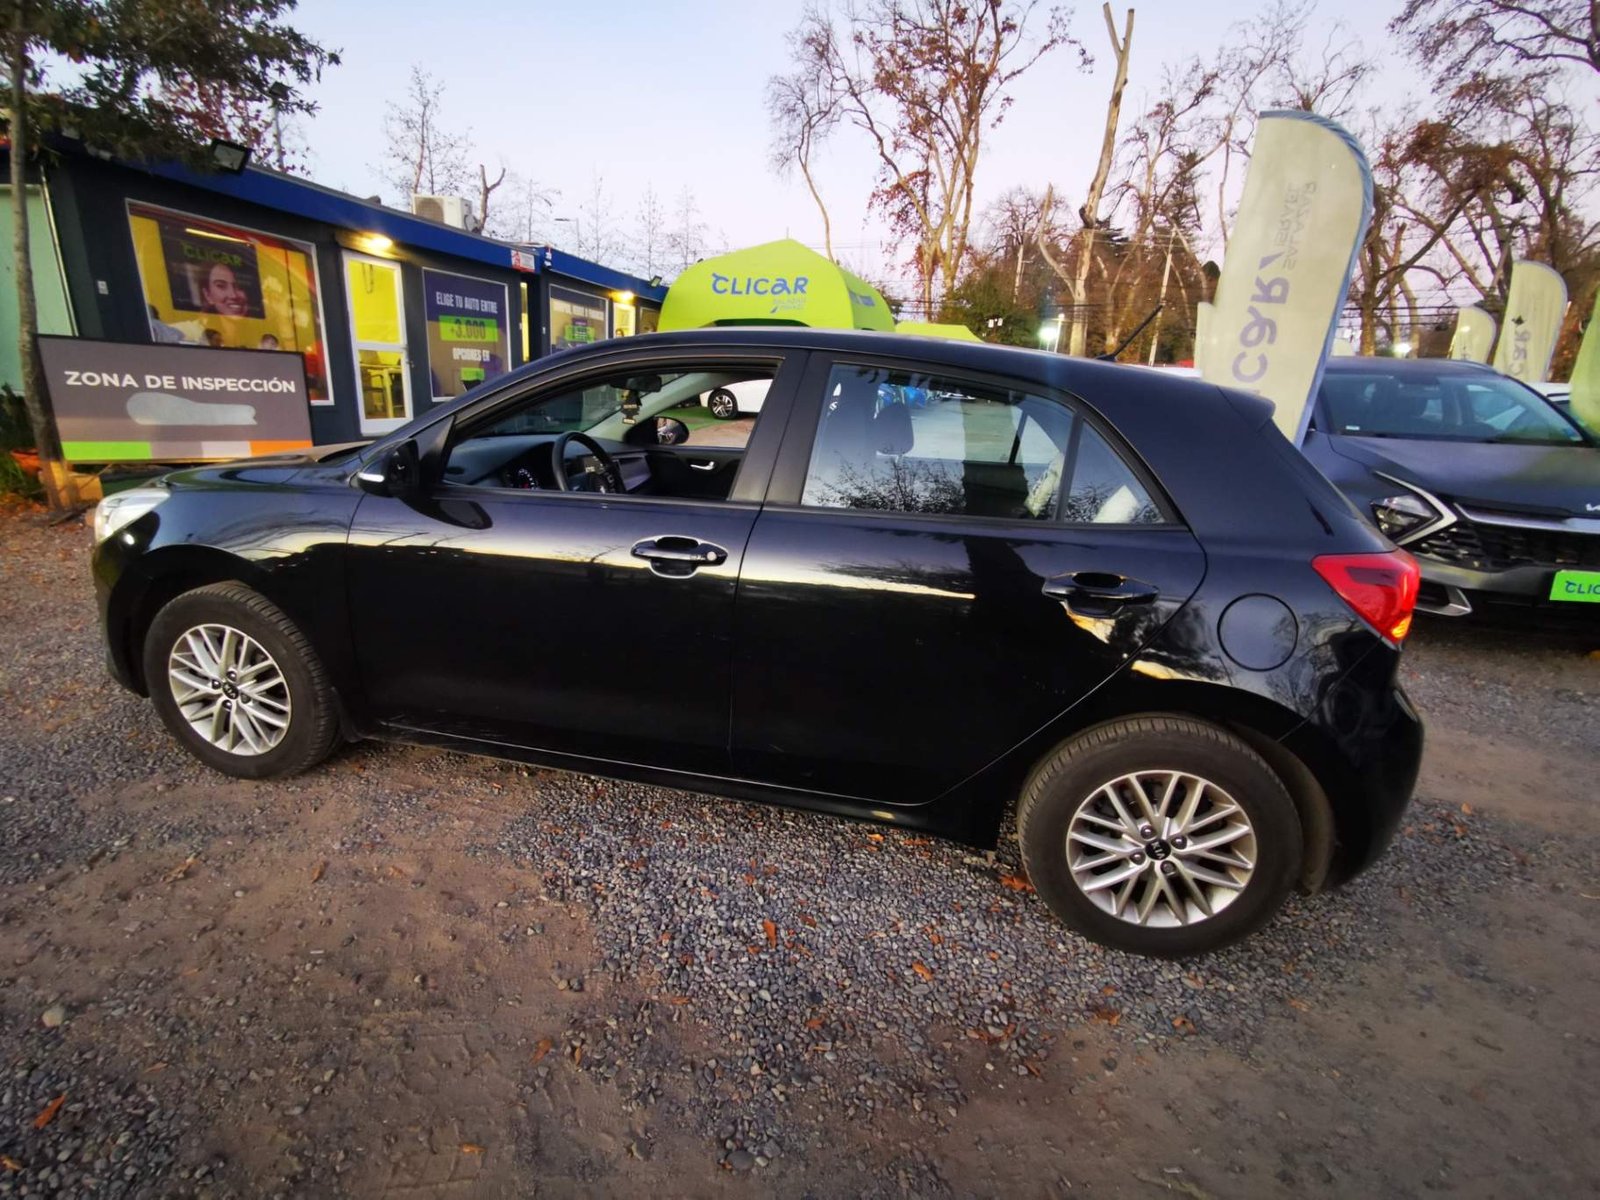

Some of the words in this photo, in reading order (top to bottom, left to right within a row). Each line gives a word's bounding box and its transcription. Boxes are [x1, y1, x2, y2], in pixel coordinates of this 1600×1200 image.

[436, 291, 454, 307] ELIGE
[64, 371, 139, 388] ZONA
[145, 374, 177, 389] DE
[182, 376, 296, 393] INSPECCIÓN
[1151, 841, 1165, 859] KIA
